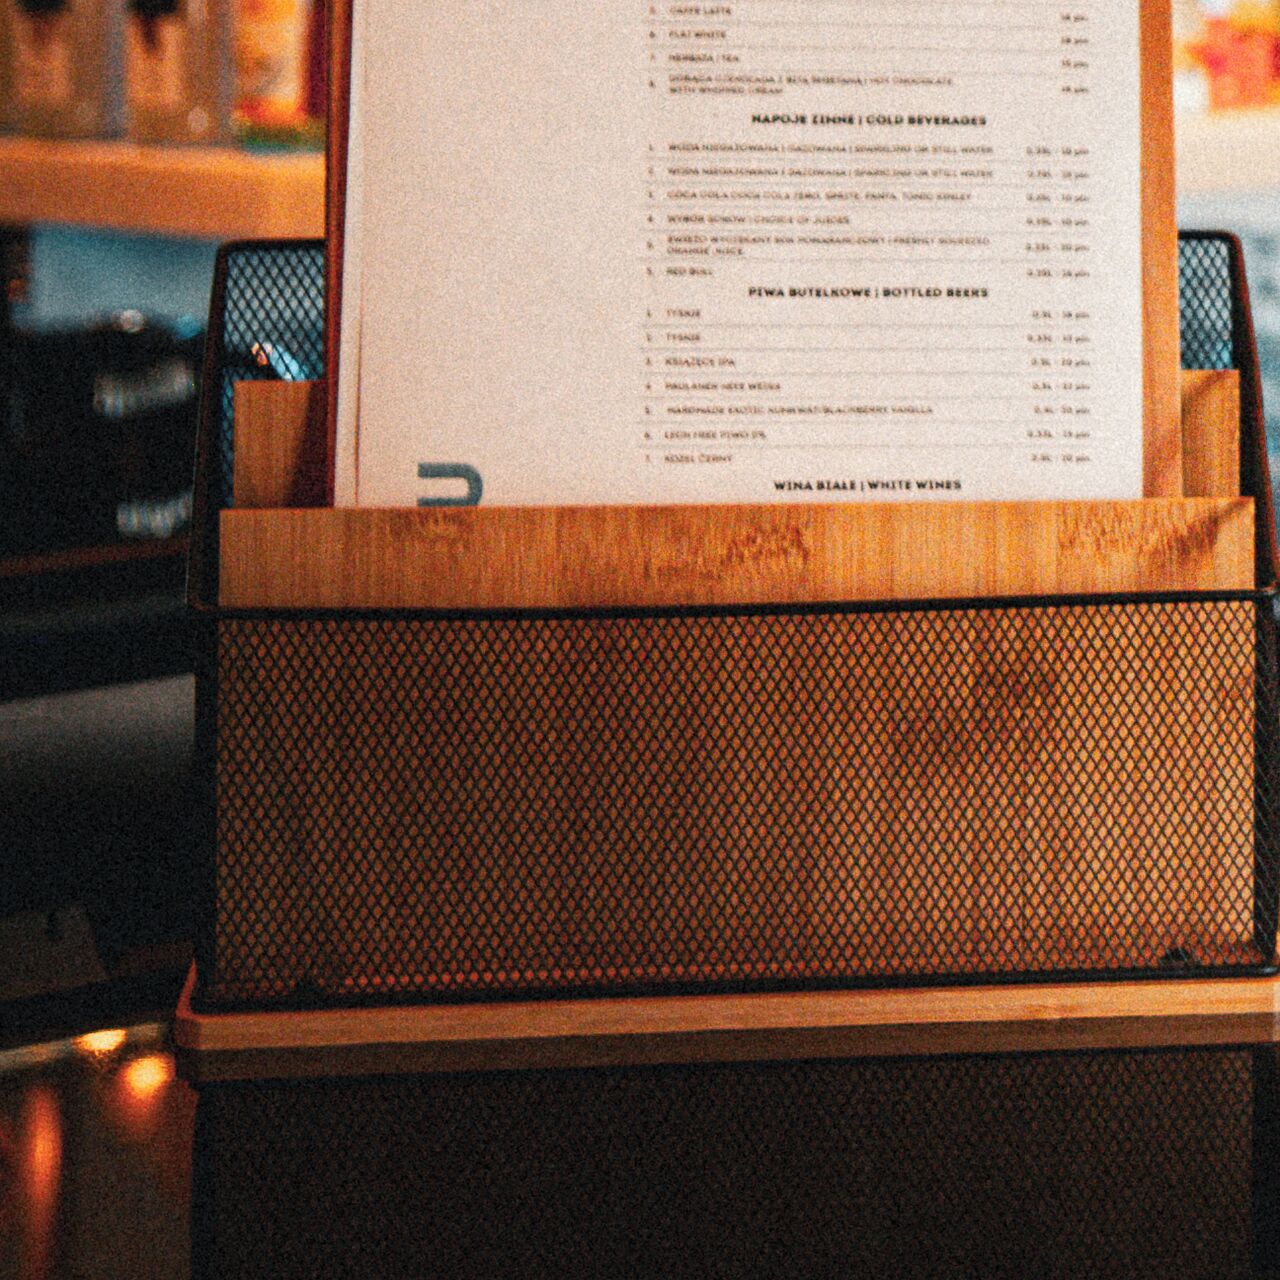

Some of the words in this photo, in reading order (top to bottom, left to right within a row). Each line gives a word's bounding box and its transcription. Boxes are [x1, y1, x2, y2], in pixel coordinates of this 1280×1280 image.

[751, 114, 806, 126] NAPOJE
[865, 115, 903, 127] COLD
[907, 115, 987, 127] BEVERAGES
[749, 287, 785, 298] PIWA
[788, 287, 871, 298] BUTELKOWE
[883, 287, 942, 298] BOTTLED
[946, 287, 989, 298] BEERS
[774, 480, 813, 491] WINA
[868, 480, 911, 491] WHITE
[916, 480, 962, 491] WINES
